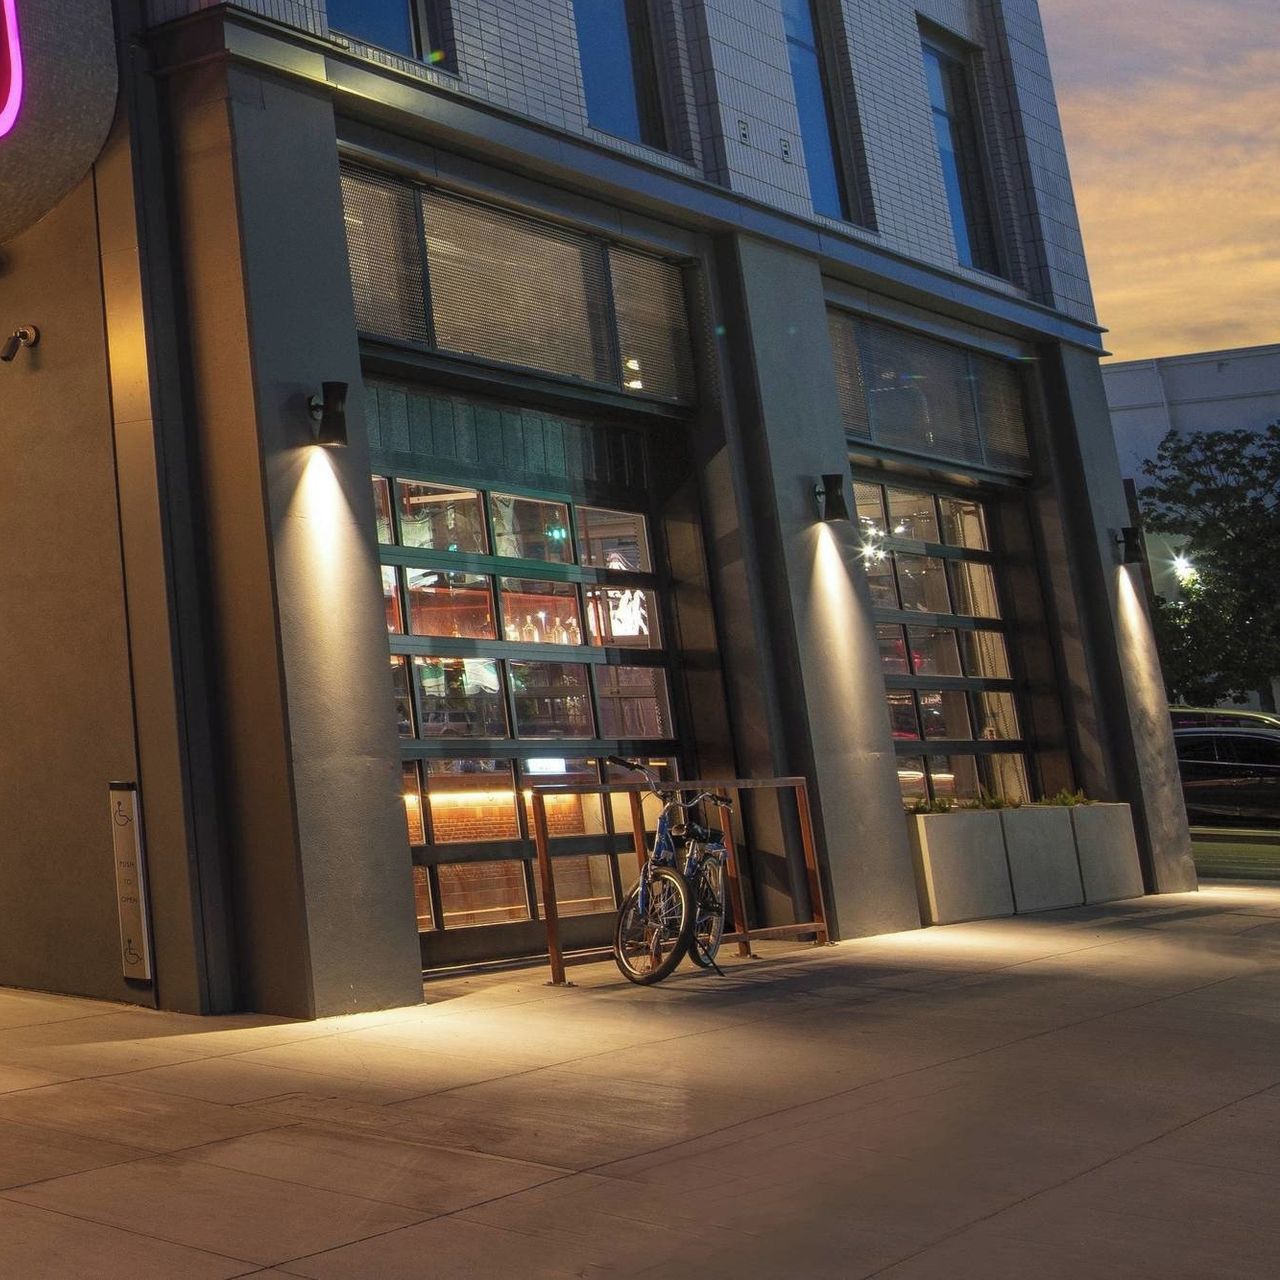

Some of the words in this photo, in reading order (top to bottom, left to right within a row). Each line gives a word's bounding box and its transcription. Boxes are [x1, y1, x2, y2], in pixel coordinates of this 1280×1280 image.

[119, 860, 135, 868] PUSH
[123, 878, 132, 886] TO
[120, 895, 138, 904] OPEN
